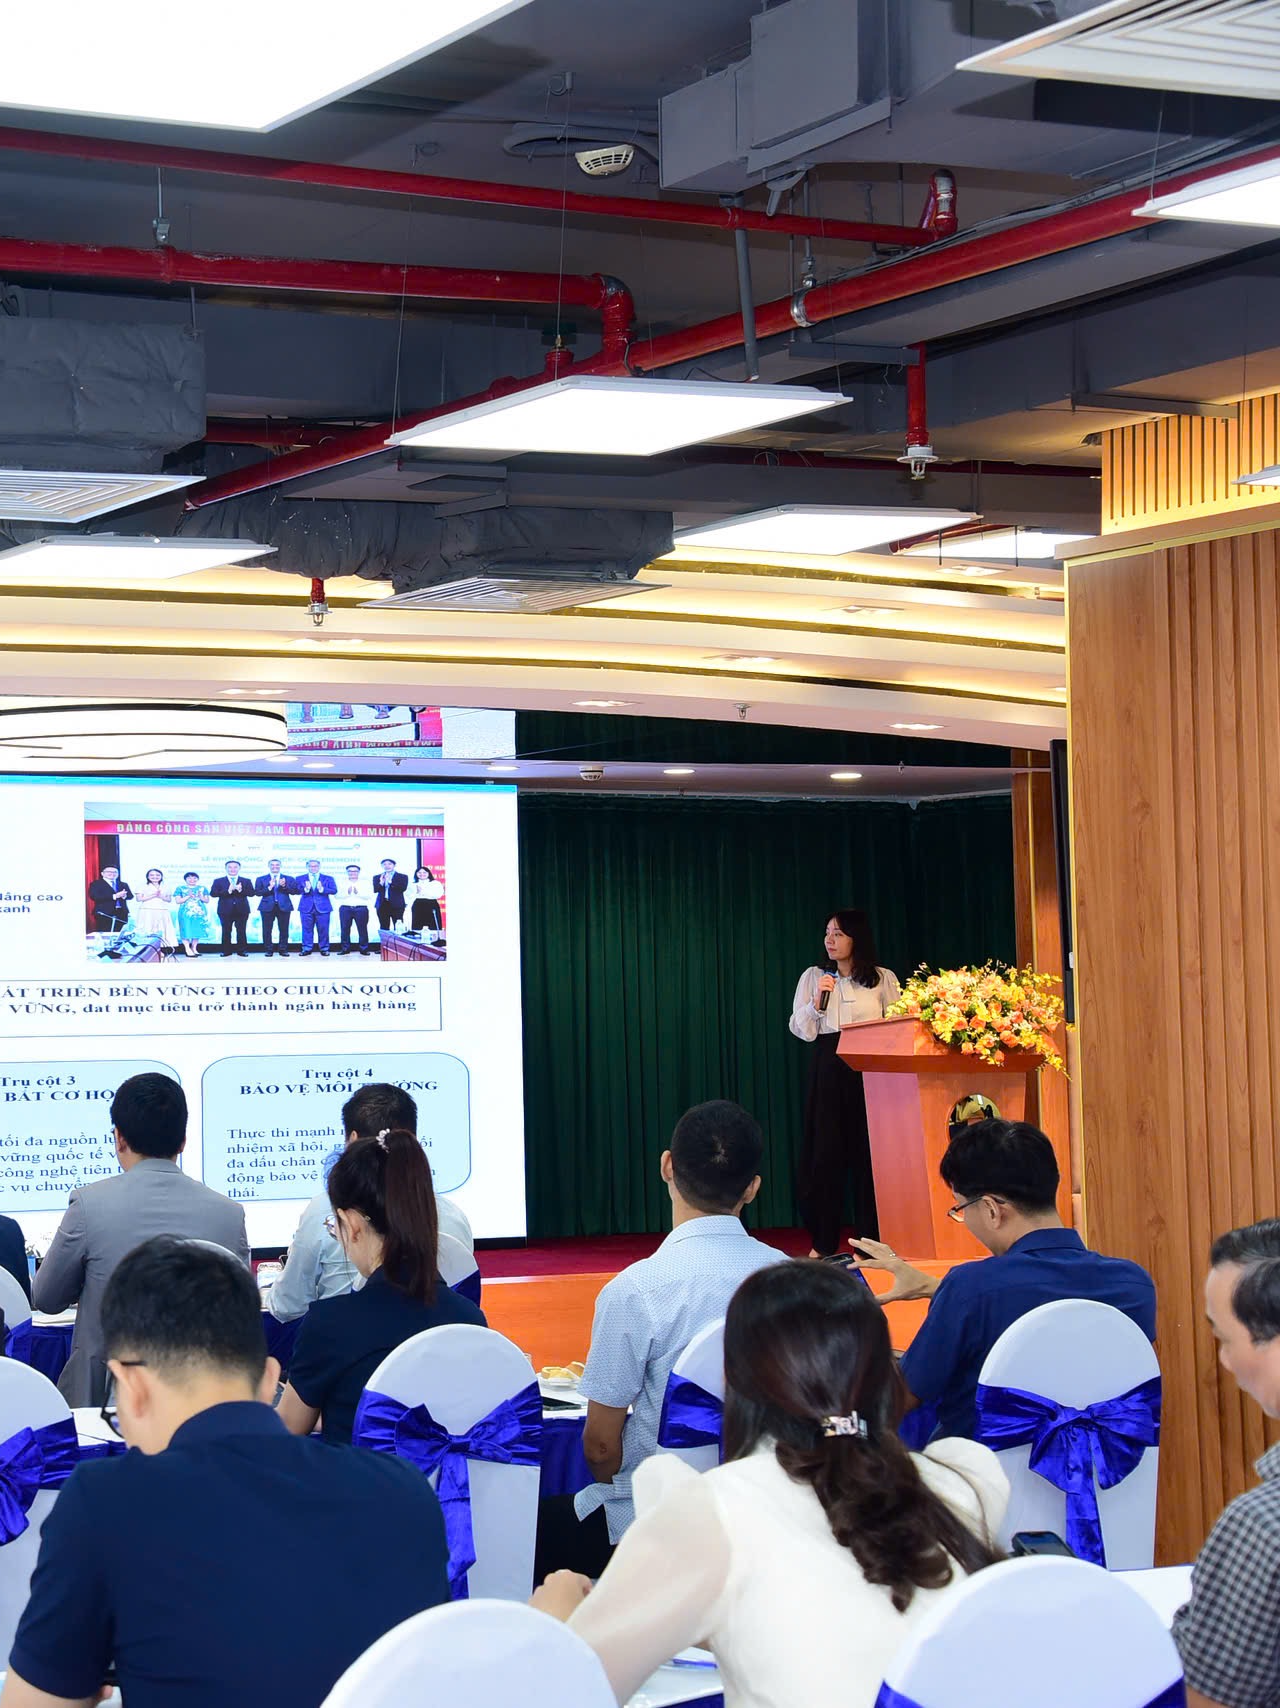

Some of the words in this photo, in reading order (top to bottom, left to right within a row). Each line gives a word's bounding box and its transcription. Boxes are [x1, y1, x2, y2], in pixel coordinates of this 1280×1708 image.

[255, 825, 285, 836] NAM
[288, 825, 330, 837] QUANG
[334, 826, 364, 837] VINH
[36, 894, 64, 902] cao
[221, 985, 278, 996] THEO
[117, 1005, 154, 1015] mục
[301, 1069, 332, 1081] Trụ
[336, 1067, 360, 1081] cột
[363, 1067, 375, 1079] 4
[36, 1075, 62, 1089] cột
[66, 1075, 76, 1086] 3
[315, 1080, 355, 1094] MÔI
[50, 1089, 81, 1101] CƠ
[226, 1128, 266, 1140] Thực
[270, 1127, 290, 1138] thi
[294, 1125, 336, 1139] mạnh
[24, 1135, 44, 1147] đa
[48, 1131, 99, 1149] nguồn
[0, 1151, 41, 1164] vững
[45, 1147, 85, 1163] quốc
[89, 1145, 104, 1160] tế
[226, 1142, 274, 1155] nhiệm
[300, 1140, 330, 1155] hội,
[226, 1158, 245, 1169] đa
[249, 1155, 276, 1168] dấu
[281, 1156, 316, 1167] chân
[39, 1164, 79, 1179] nghệ
[82, 1164, 111, 1175] tiên
[226, 1172, 265, 1185] động
[227, 1186, 260, 1199] thái.
